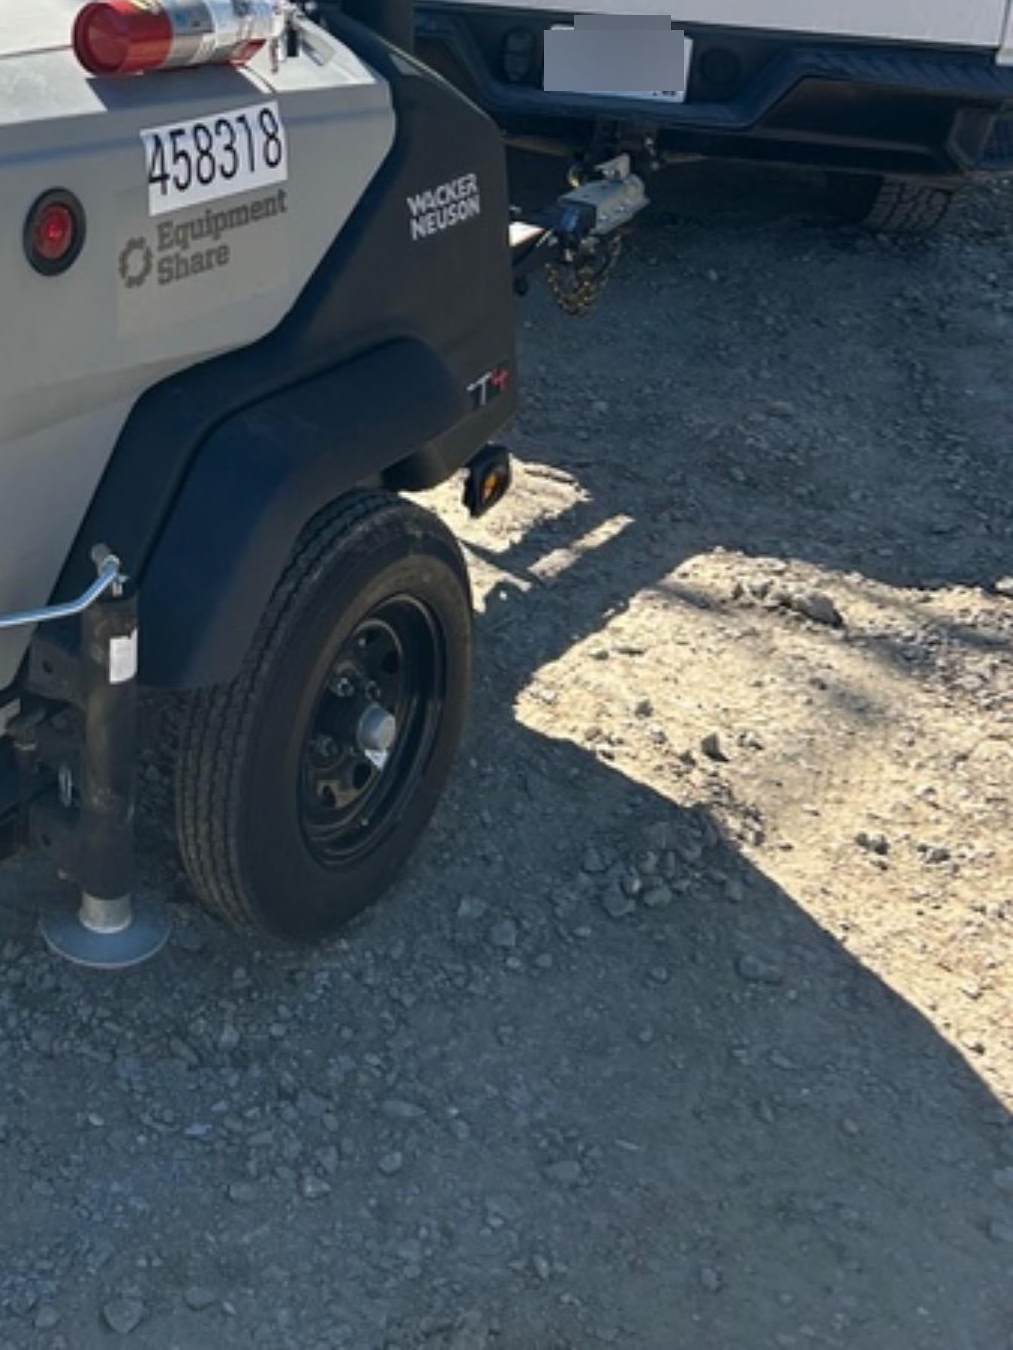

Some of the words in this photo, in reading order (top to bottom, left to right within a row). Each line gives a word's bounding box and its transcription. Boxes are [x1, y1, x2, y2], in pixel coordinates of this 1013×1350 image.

[148, 107, 282, 197] 458318
[406, 172, 479, 218] WACKER
[409, 193, 481, 242] NEUSON
[156, 188, 288, 252] Equipment
[156, 244, 230, 286] Share
